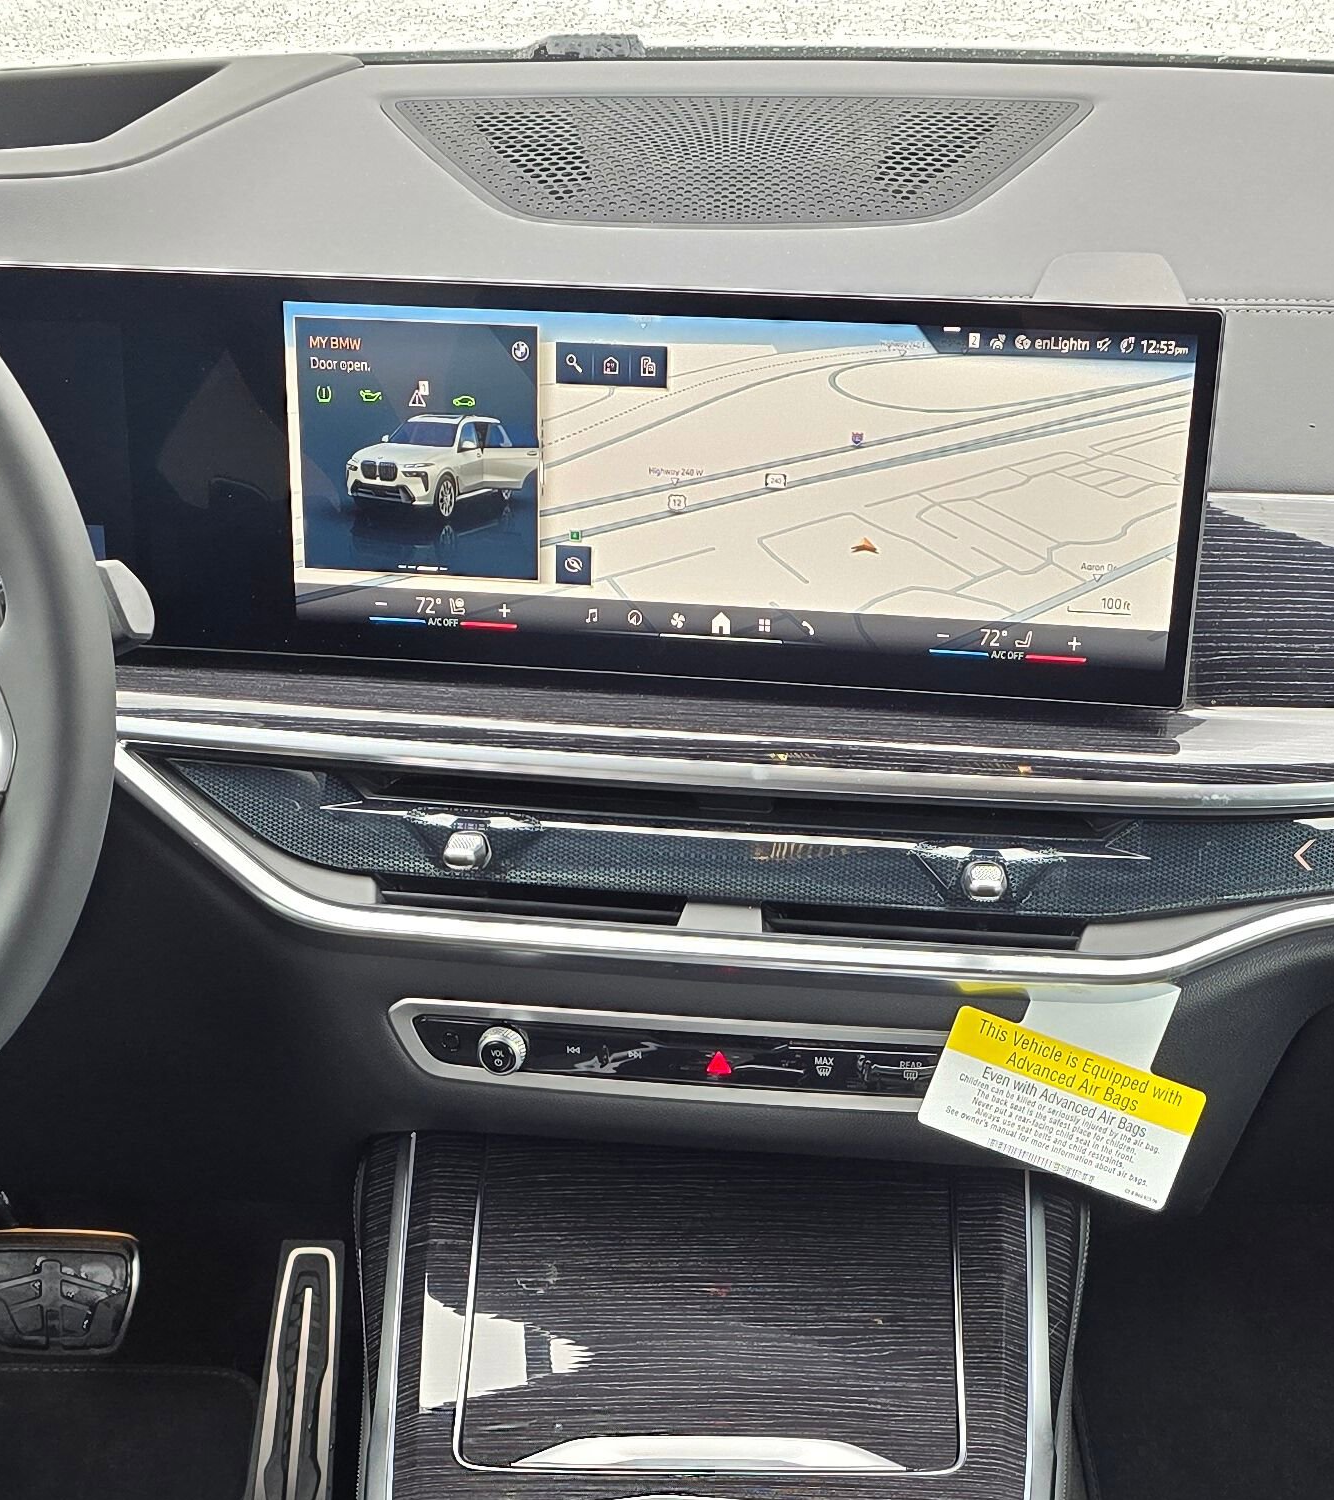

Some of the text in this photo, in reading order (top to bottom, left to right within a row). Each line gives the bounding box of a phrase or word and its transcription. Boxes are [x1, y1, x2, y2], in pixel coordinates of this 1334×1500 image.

[309, 336, 361, 350] MY BMW
[1035, 337, 1090, 353] enLightn
[310, 357, 370, 373] Door open.
[649, 467, 679, 477] Highway
[673, 499, 681, 507] 12
[416, 597, 441, 614] 72°
[1101, 598, 1121, 609] 100
[428, 618, 458, 627] A/C OFF
[980, 629, 1007, 646] 72°
[991, 651, 1024, 660] A/C OFF
[814, 1056, 834, 1066] MAX
[979, 1018, 1182, 1106] This Vehicle is Equipped with
[1005, 1051, 1138, 1111] Advanced Air Bags
[981, 1065, 1147, 1137] Even with Advanced Air Bags
[958, 1072, 1160, 1154] Children can be killed or seriously injured by the air bag.
[976, 1087, 1136, 1155] The back seat is the safest place for children.
